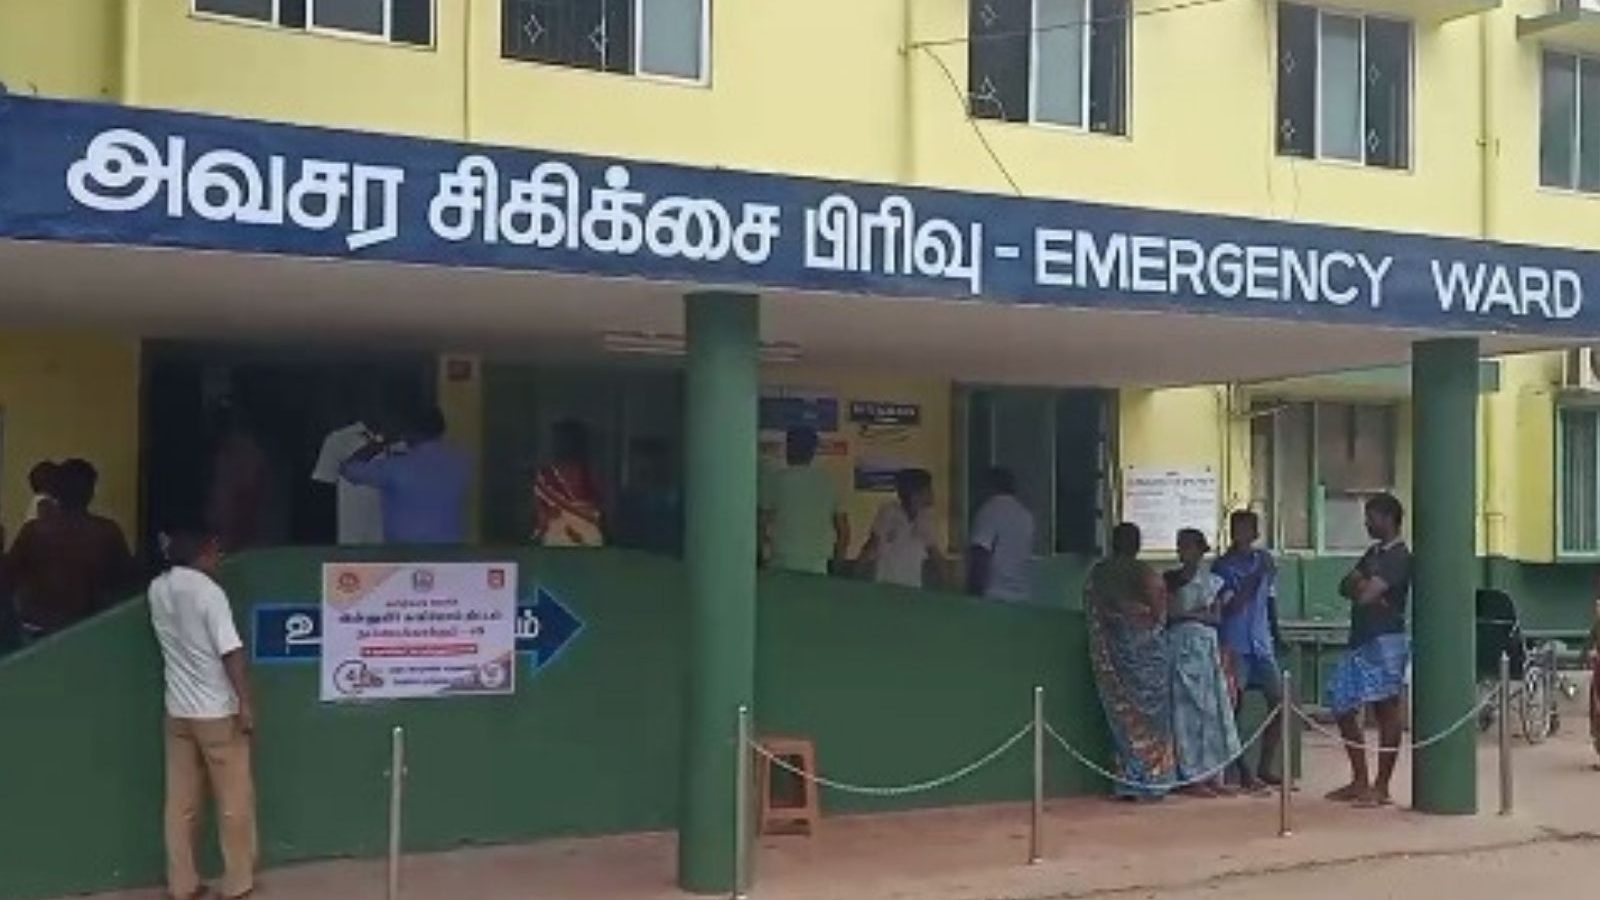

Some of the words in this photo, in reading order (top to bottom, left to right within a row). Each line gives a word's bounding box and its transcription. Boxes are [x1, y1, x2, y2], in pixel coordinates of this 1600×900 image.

[66, 129, 404, 250] அவசர
[804, 194, 983, 295] பிரிவு
[1035, 228, 1394, 307] EMERGENCY
[1430, 259, 1582, 318] WARD
